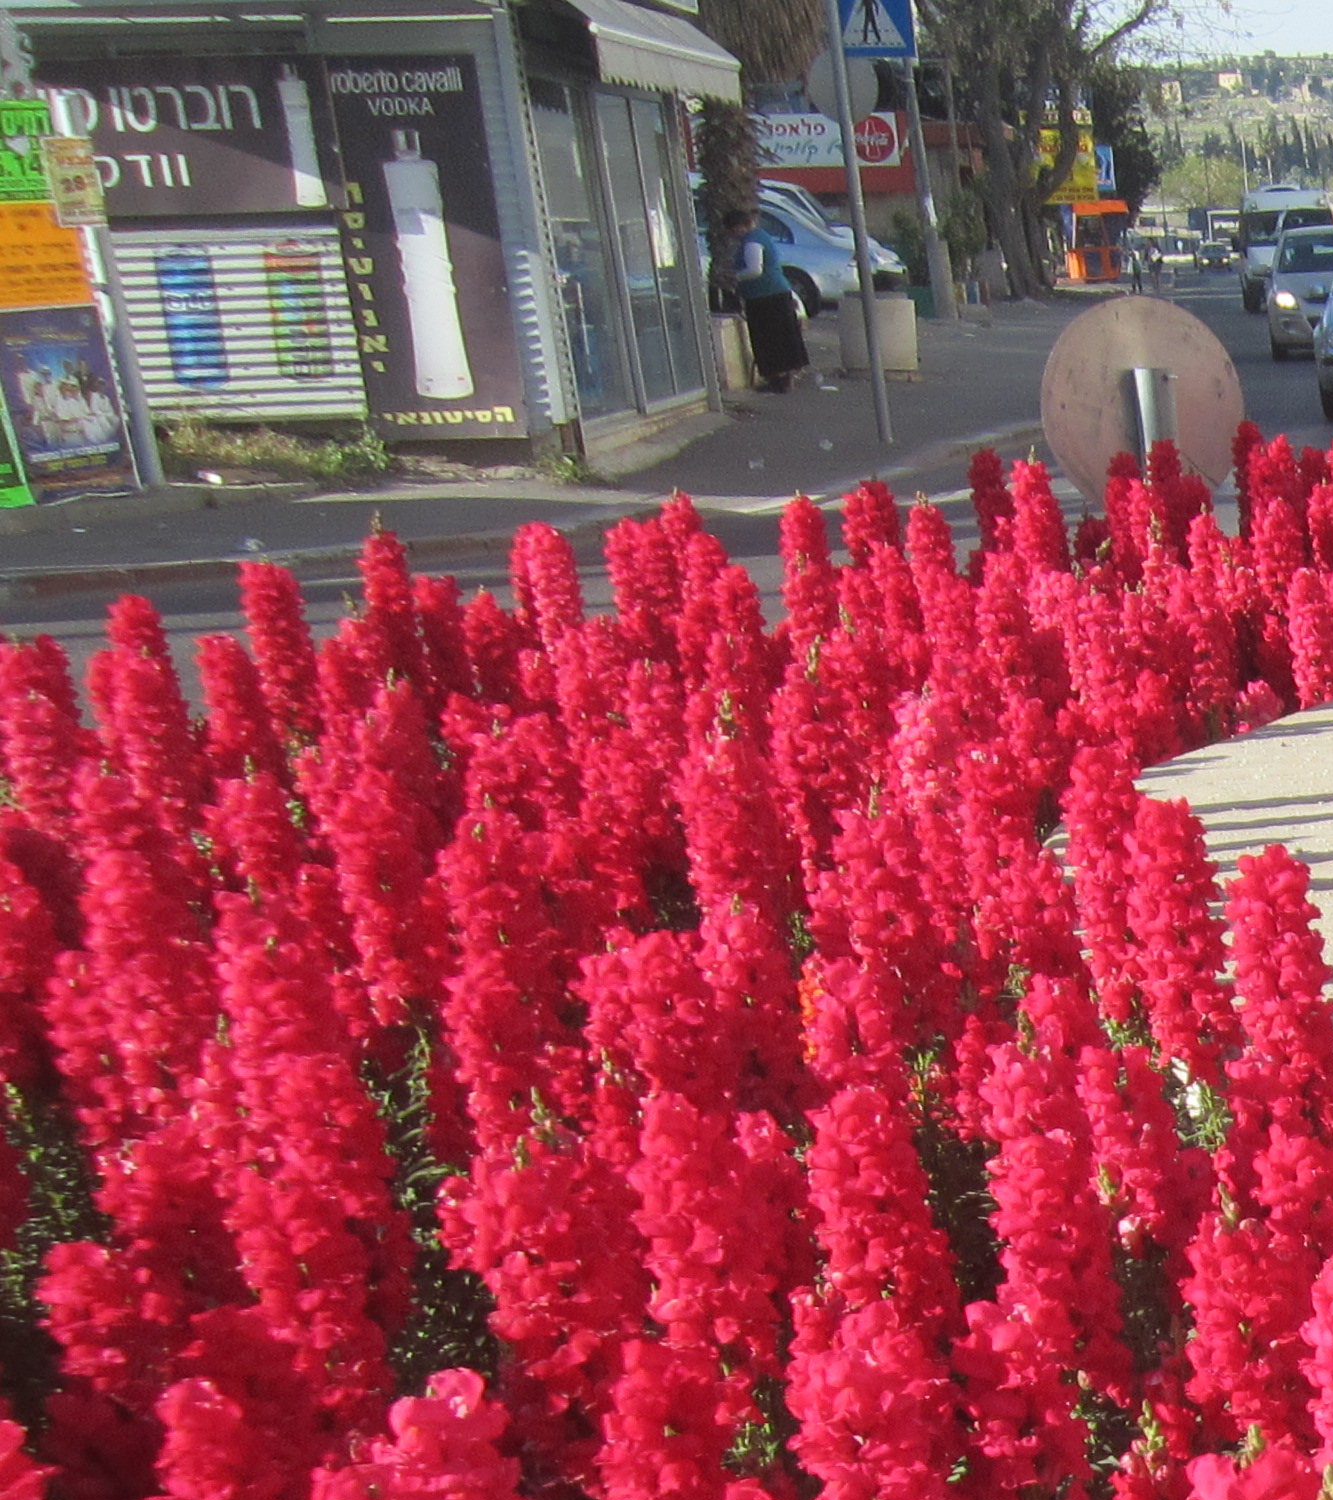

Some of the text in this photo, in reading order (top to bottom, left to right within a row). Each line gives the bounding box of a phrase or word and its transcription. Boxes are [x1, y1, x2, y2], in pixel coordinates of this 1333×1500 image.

[331, 65, 464, 94] roberto cavalli
[107, 84, 263, 133] רוברטו
[366, 97, 436, 117] VODKA
[763, 117, 827, 136] פלאפל
[92, 153, 192, 188] וודק
[382, 406, 516, 426] הסיטונאי
